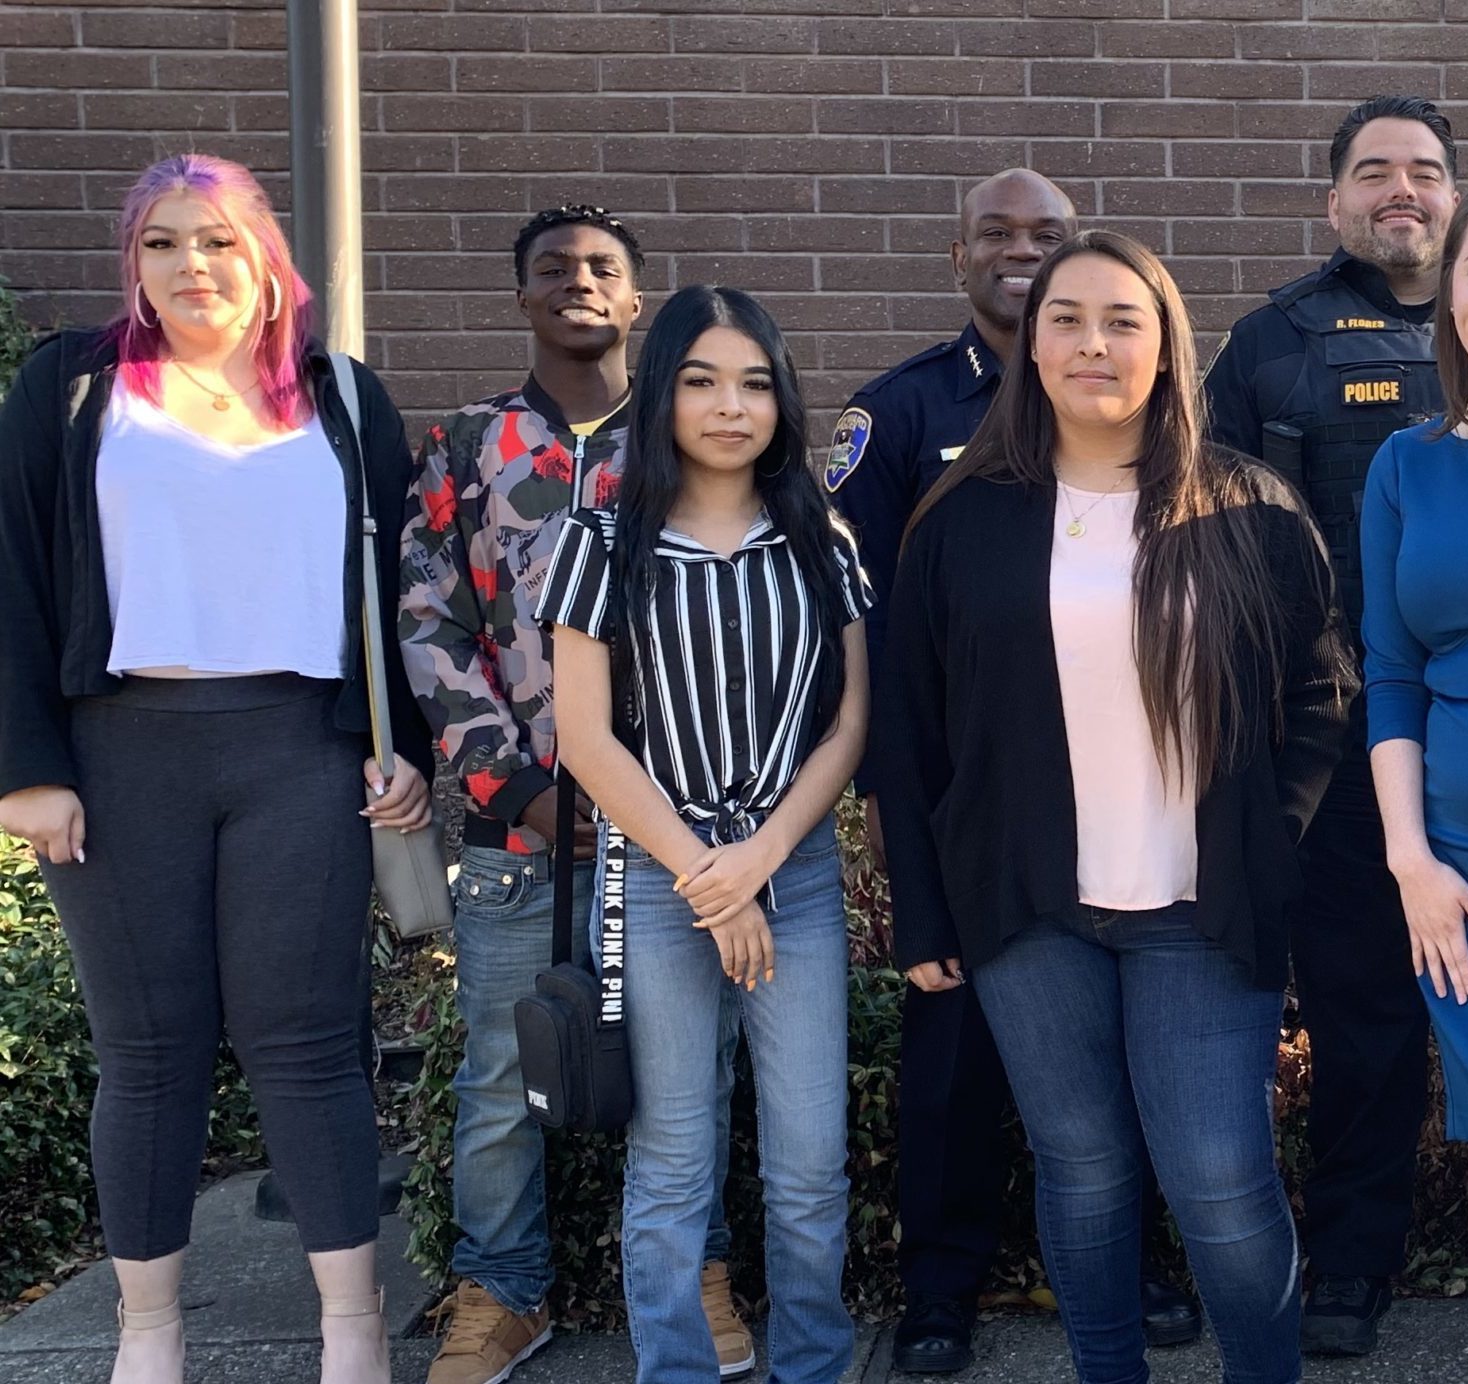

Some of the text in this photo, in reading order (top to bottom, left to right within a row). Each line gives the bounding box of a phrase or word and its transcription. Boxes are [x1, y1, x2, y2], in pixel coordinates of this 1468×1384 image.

[1348, 318, 1386, 329] FLORES
[1344, 381, 1400, 403] POLICE
[604, 858, 624, 910] PINK
[602, 918, 623, 969] PINK
[527, 1089, 549, 1110] PINK
